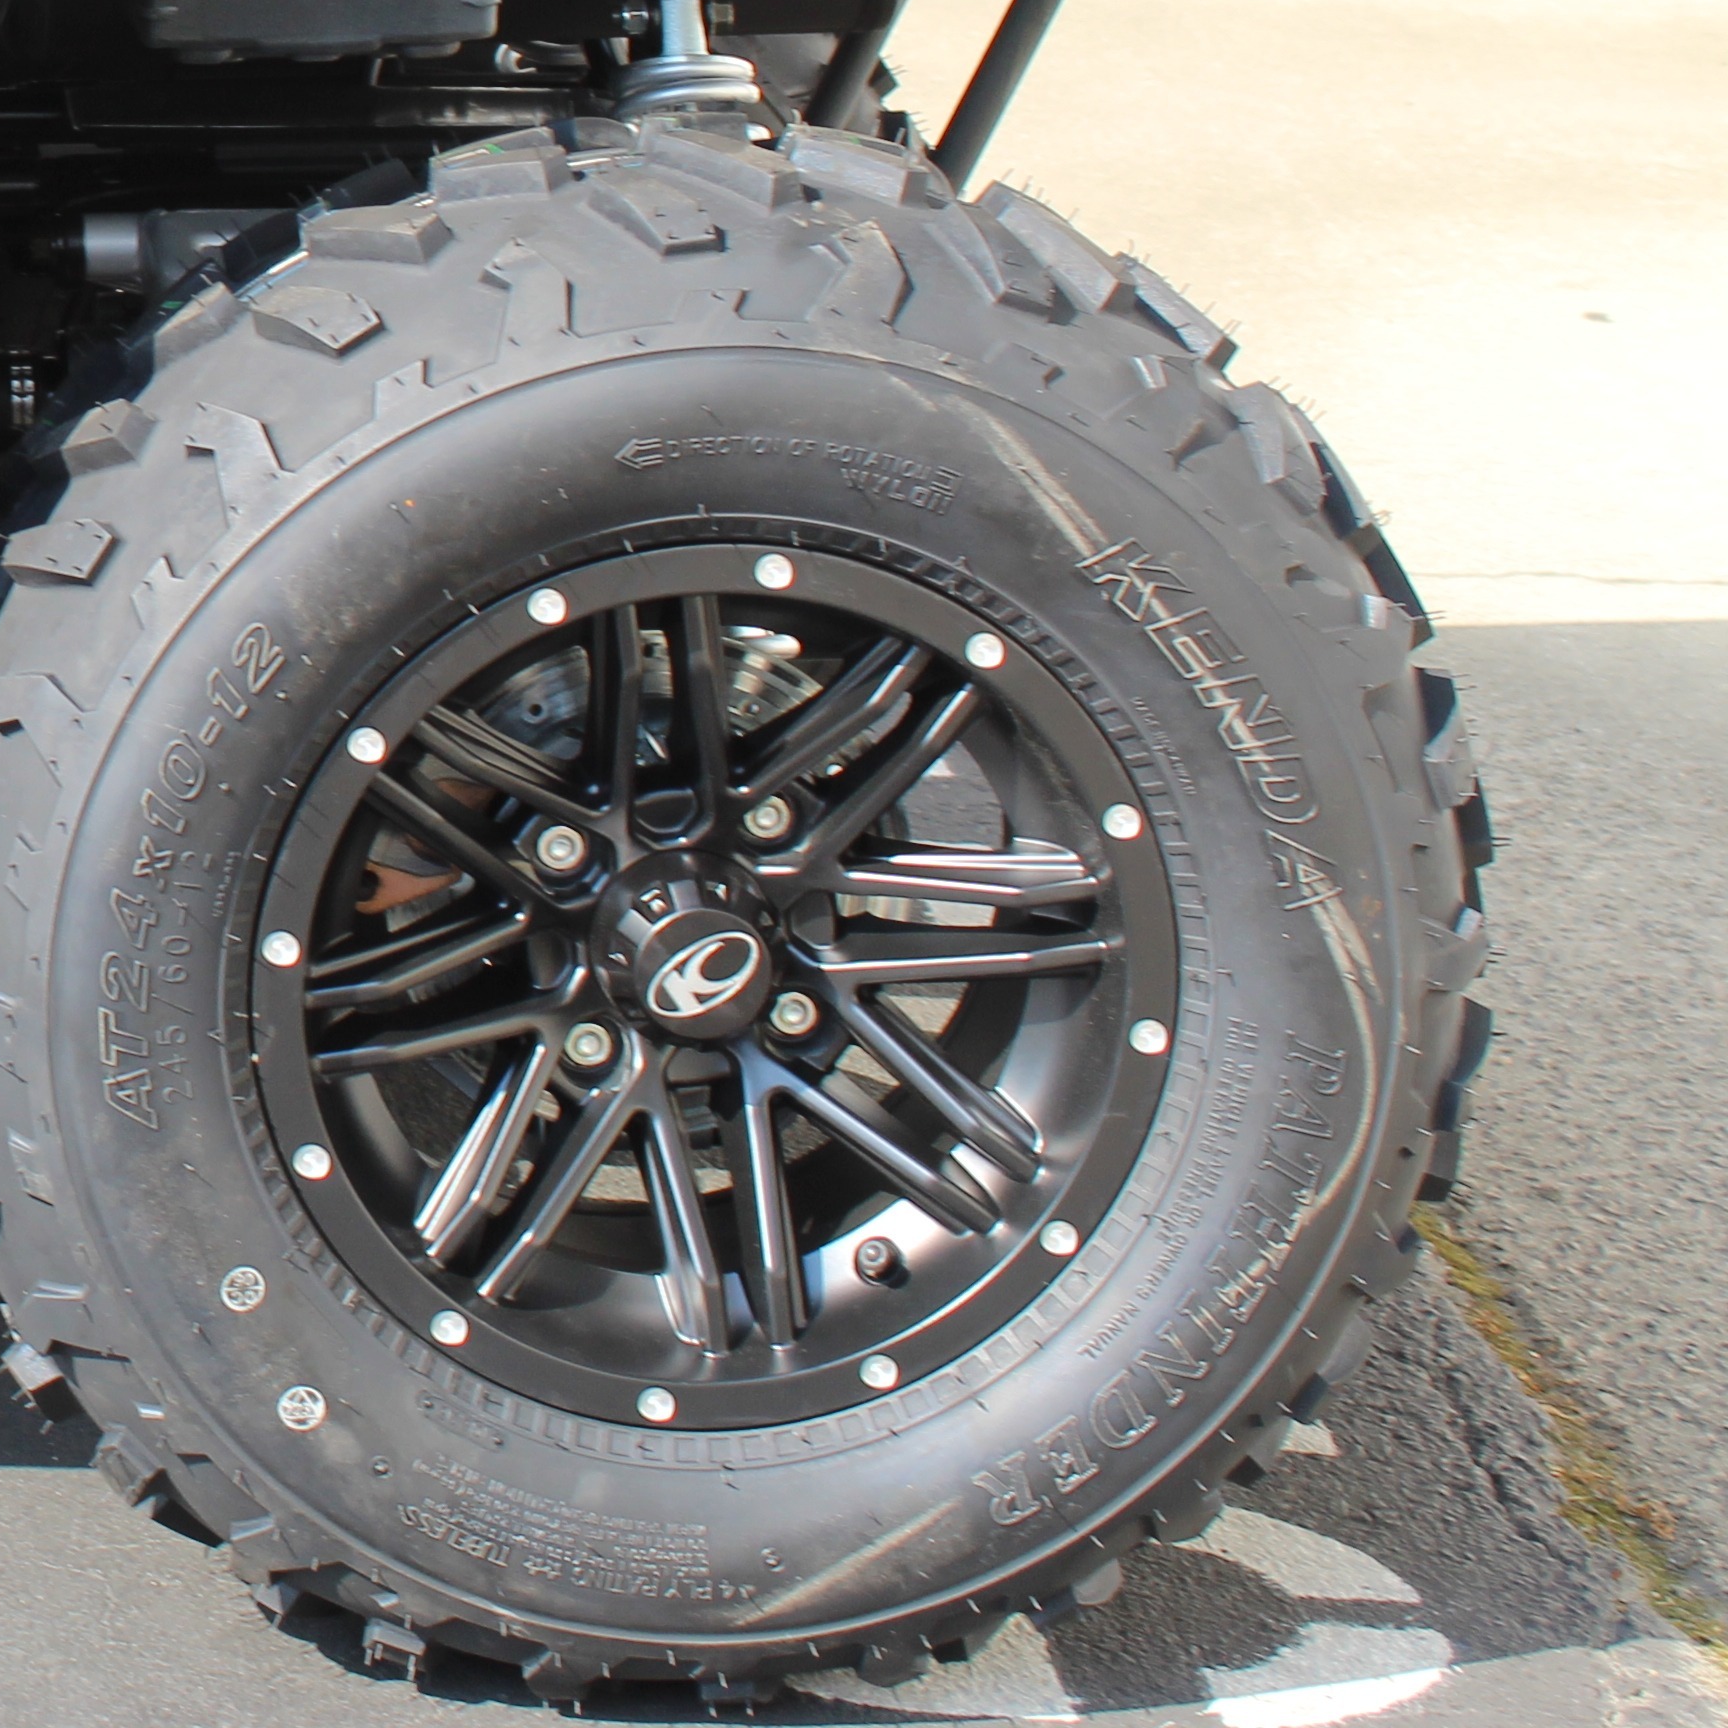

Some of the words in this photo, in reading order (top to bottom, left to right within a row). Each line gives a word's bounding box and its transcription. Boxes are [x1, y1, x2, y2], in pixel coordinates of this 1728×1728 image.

[663, 435, 781, 459] DIRECTION
[789, 435, 818, 459] OF
[823, 438, 934, 480] ROTATION
[841, 465, 954, 518] NYLON
[1073, 536, 1341, 912] KENDA
[100, 621, 287, 1132] AT24x10-12
[153, 846, 214, 1106] 245/60-12
[1194, 1055, 1238, 1155] OPERATING
[1217, 1061, 1256, 1142] VEHICLE
[1150, 1157, 1209, 1246] PRESSURE
[1191, 1143, 1234, 1205] LABEL
[1178, 1203, 1206, 1232] OR
[971, 1030, 1350, 1526] PATHFINDER
[1130, 1229, 1192, 1303] OWNER'S
[1074, 1296, 1143, 1365] MANUAL
[394, 1500, 515, 1569] TUBELESS
[567, 1564, 659, 1597] RATING
[662, 1577, 712, 1599] PLY
[717, 1576, 735, 1599] 4
